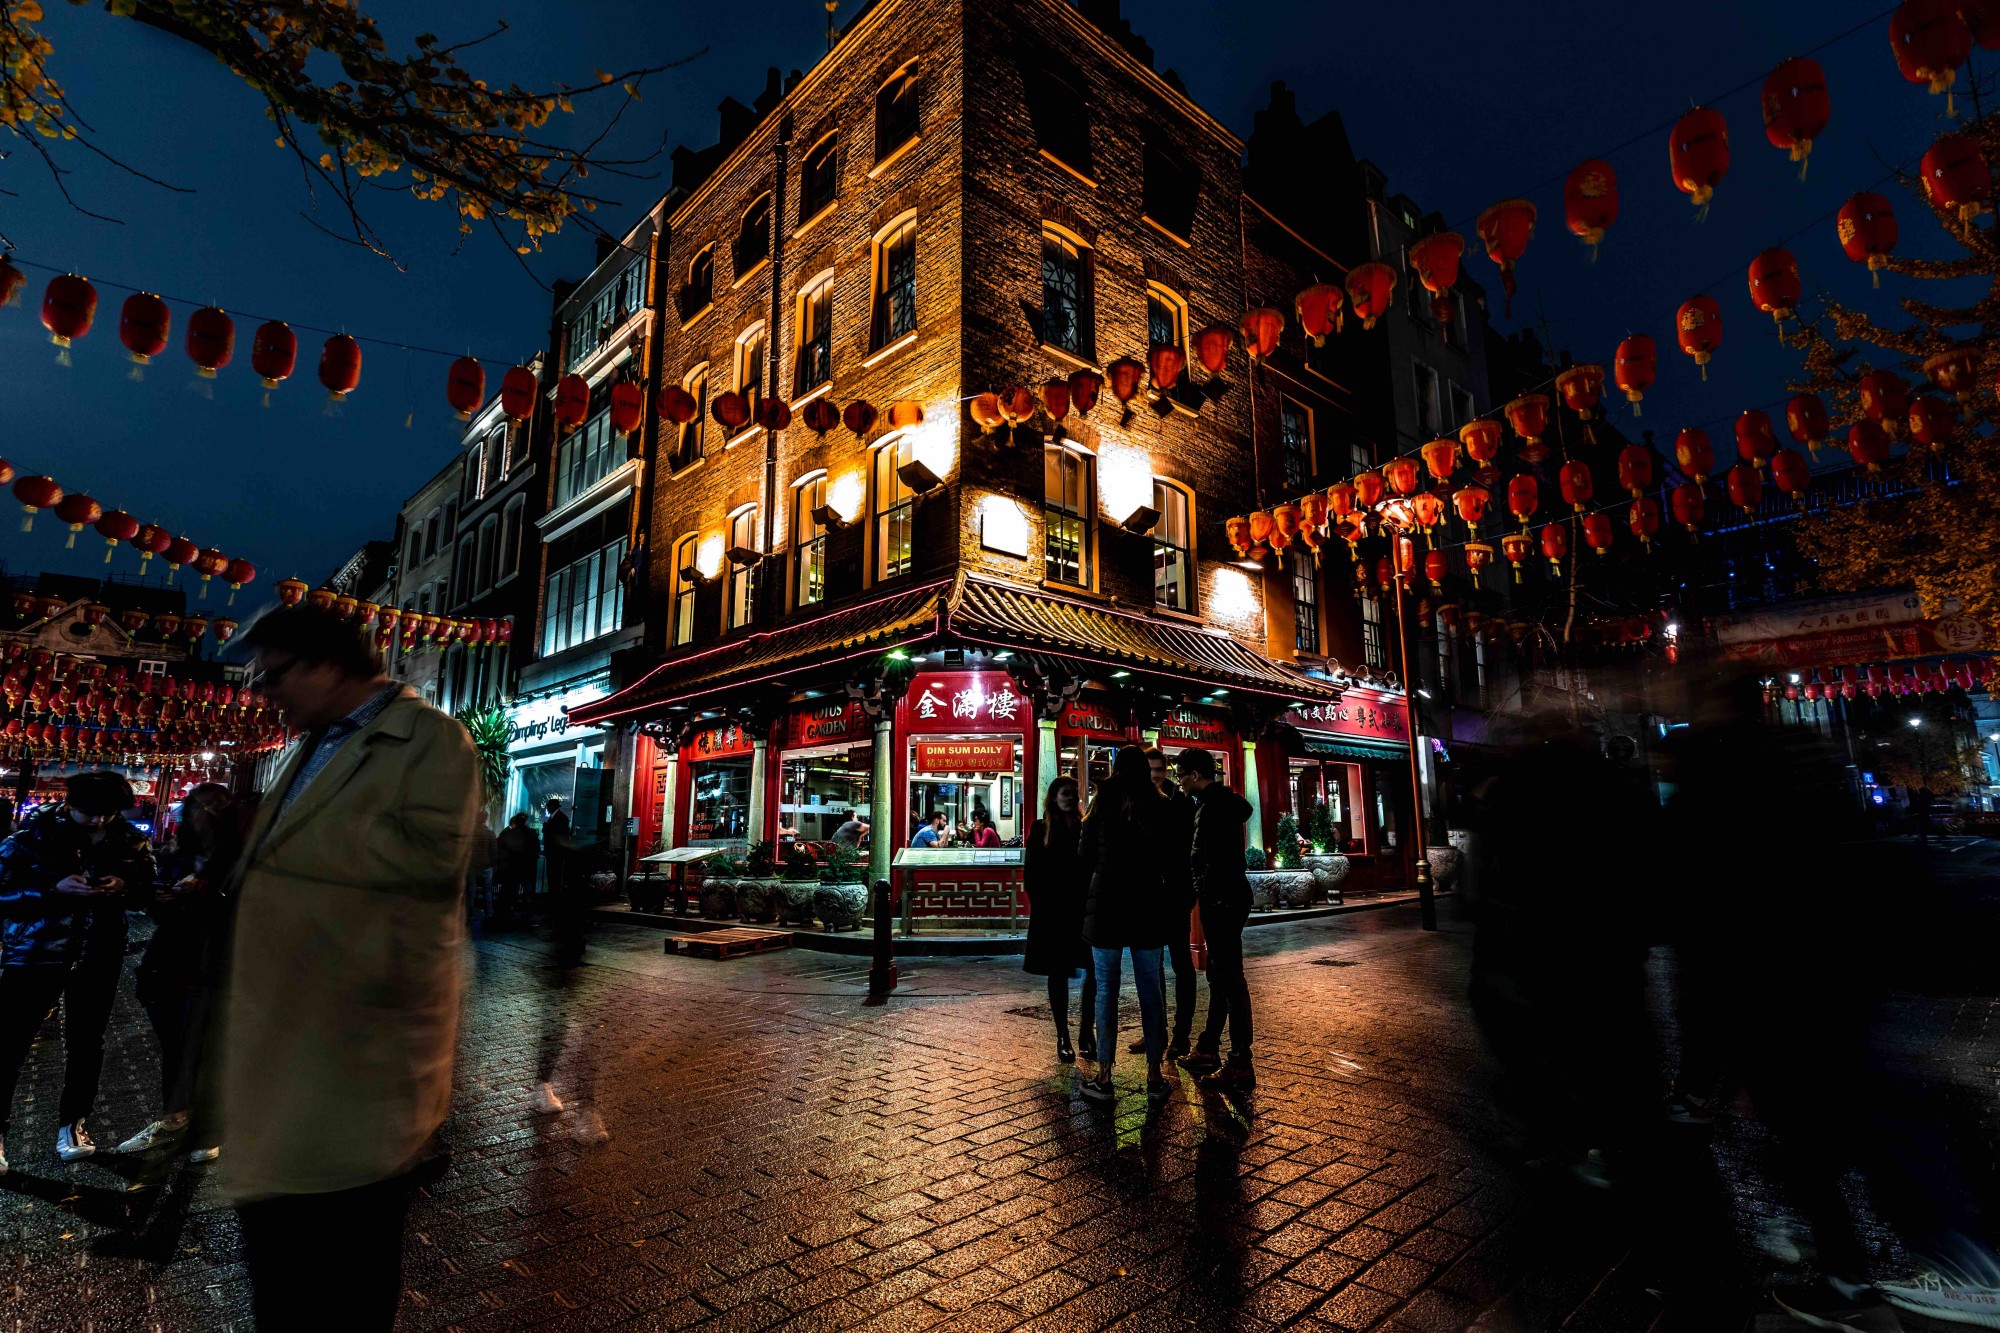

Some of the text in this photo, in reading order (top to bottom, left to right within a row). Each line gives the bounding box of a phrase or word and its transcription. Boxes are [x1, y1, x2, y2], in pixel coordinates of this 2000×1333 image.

[812, 704, 843, 722] LOTUS
[913, 689, 1018, 721] 金滿樓
[807, 719, 847, 740] GARDEN
[1068, 713, 1119, 732] GARDEN
[1162, 724, 1225, 744] RESTAURANT
[927, 746, 1003, 755] DIM SUM DAILY
